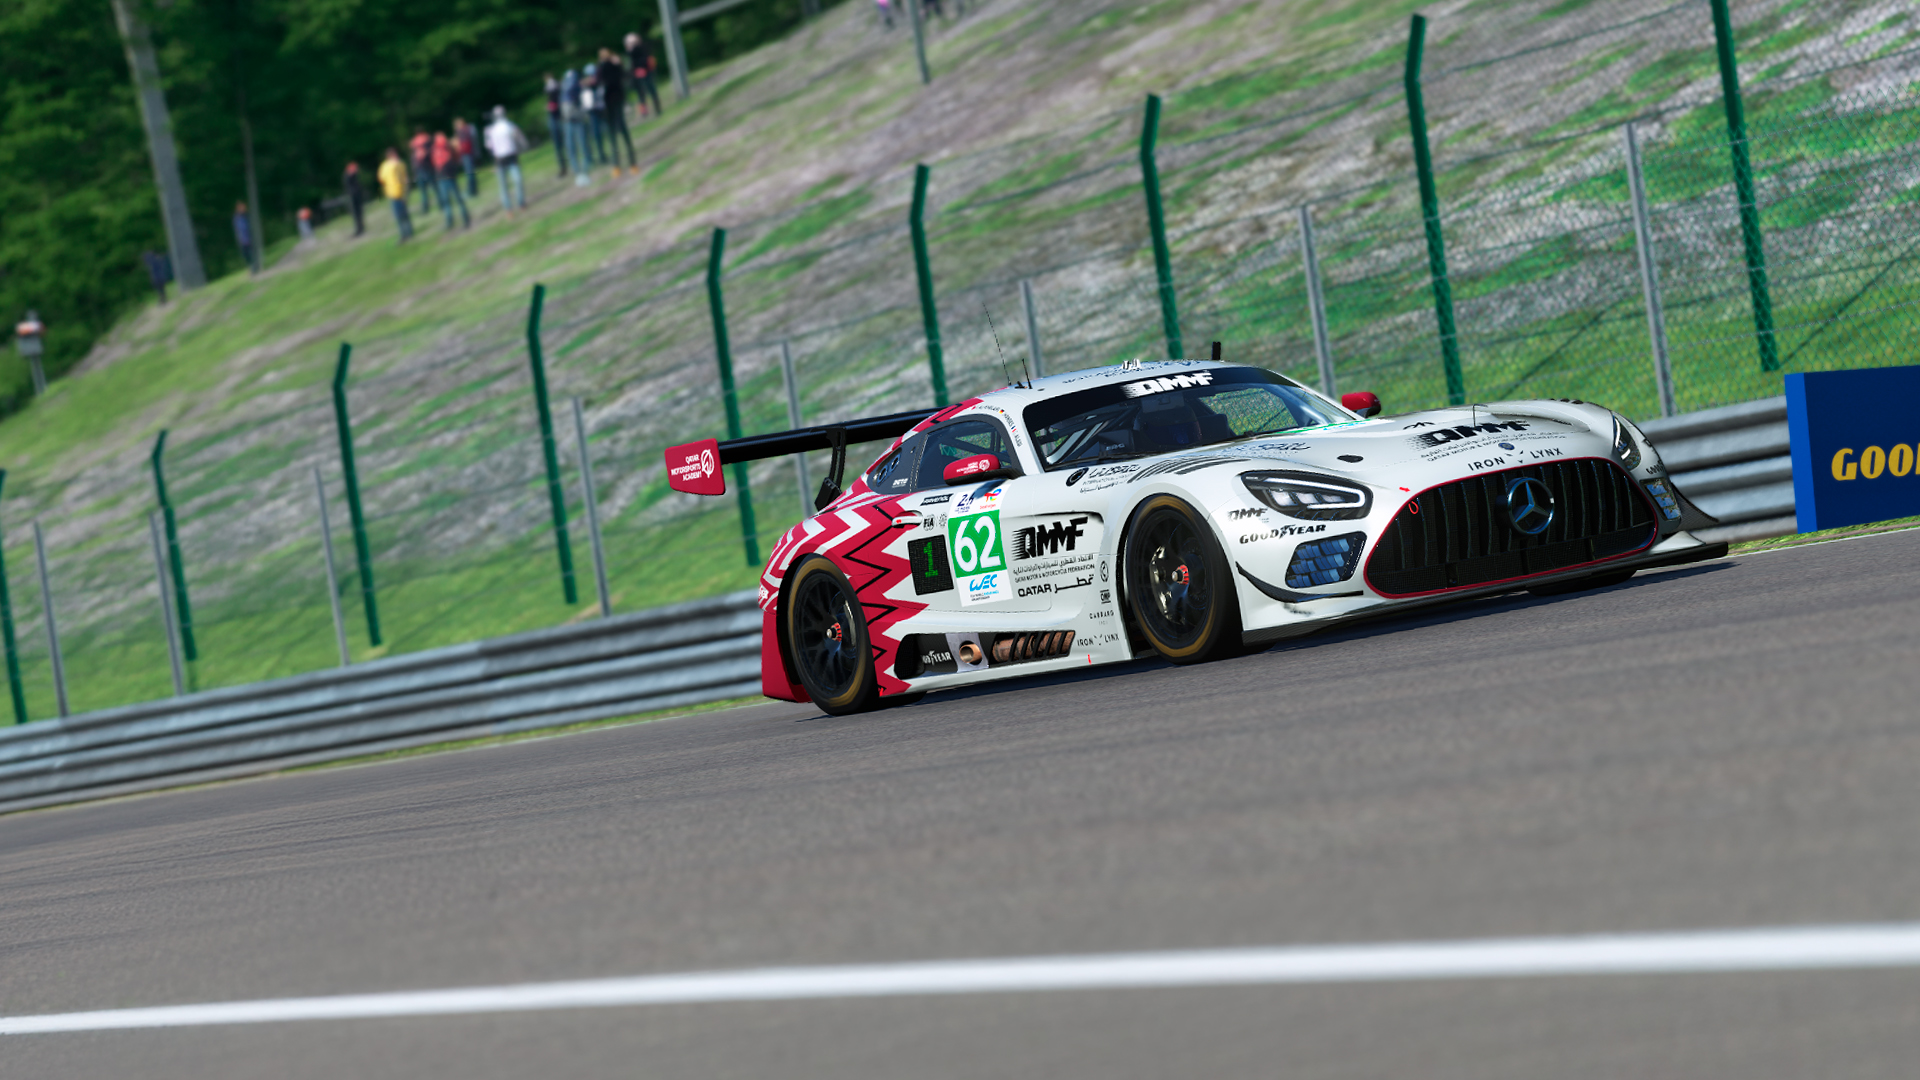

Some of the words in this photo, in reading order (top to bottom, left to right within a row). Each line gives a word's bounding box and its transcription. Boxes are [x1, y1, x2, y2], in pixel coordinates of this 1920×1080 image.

[1467, 456, 1505, 471] IRON
[1530, 447, 1563, 459] LYNX
[1831, 443, 1920, 481] GOO
[923, 517, 934, 528] FIA
[954, 515, 1001, 572] 62
[969, 574, 997, 592] WEC
[1017, 583, 1052, 597] QATAR
[1077, 638, 1094, 647] IRON
[1104, 633, 1119, 643] LYNX
